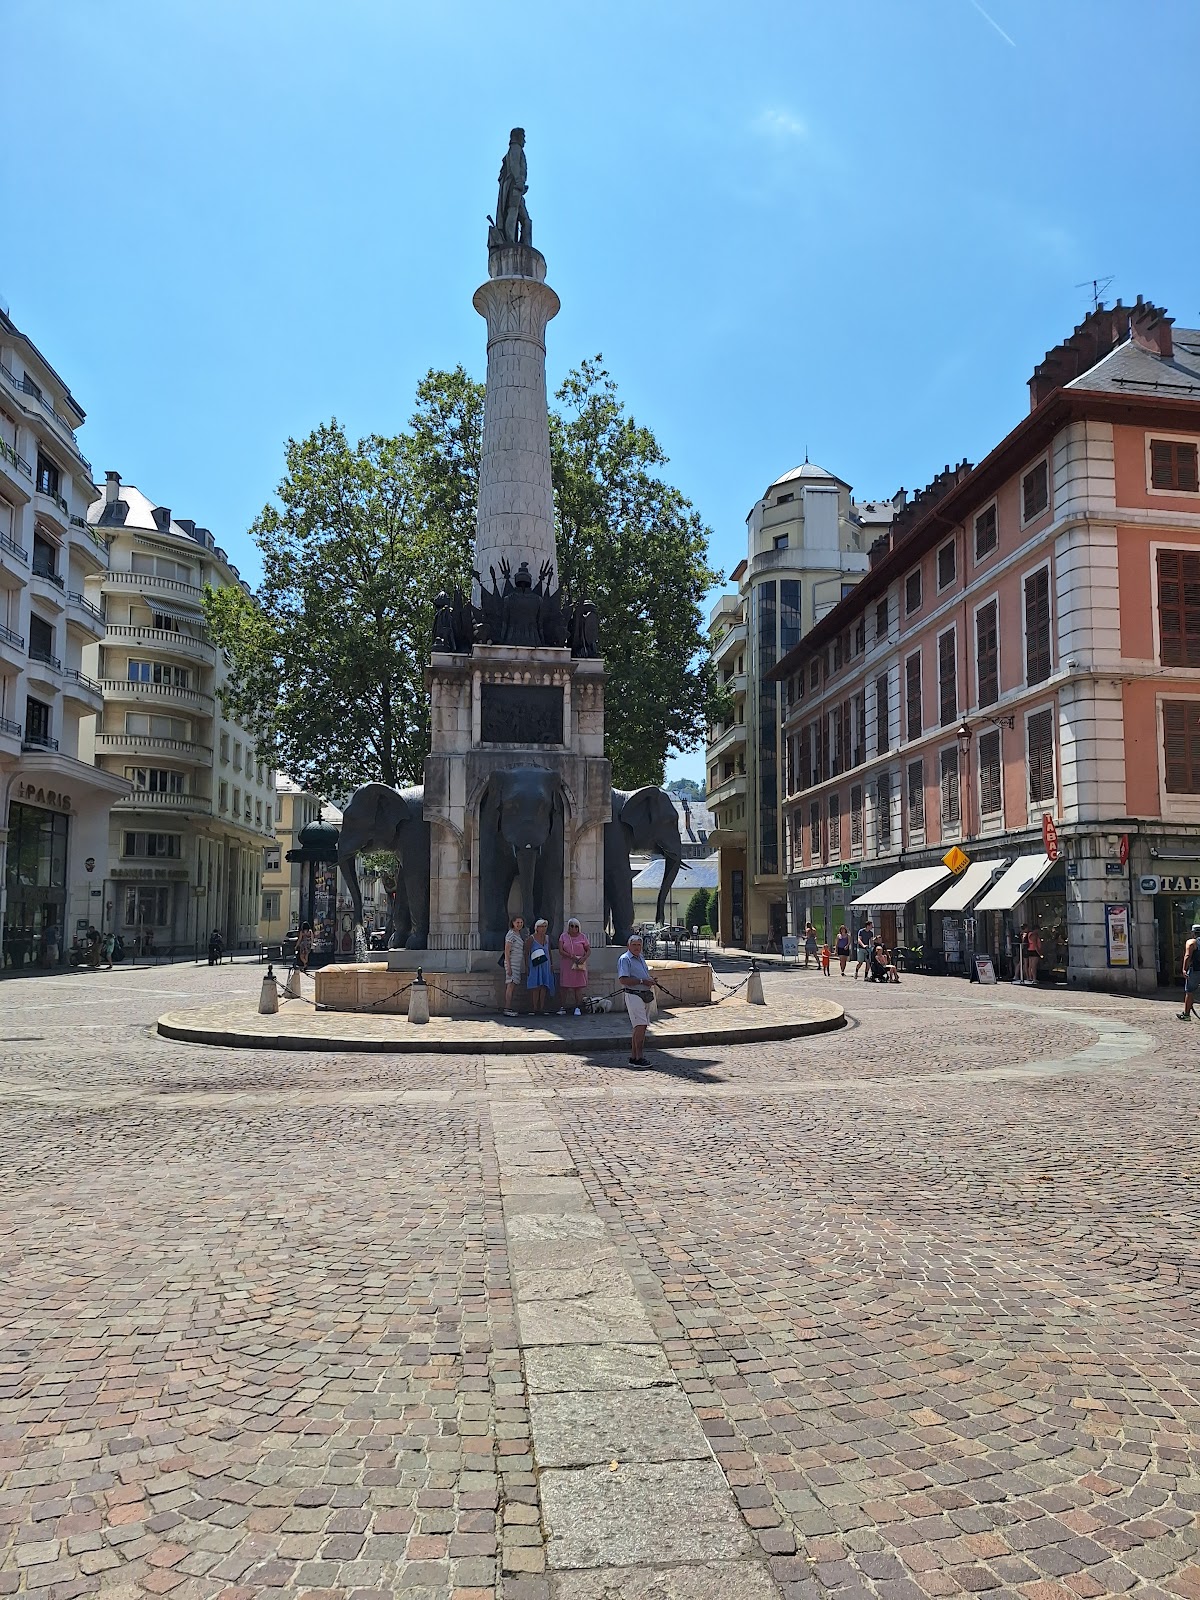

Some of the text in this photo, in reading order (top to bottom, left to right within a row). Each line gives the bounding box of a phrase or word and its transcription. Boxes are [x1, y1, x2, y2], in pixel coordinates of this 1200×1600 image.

[26, 784, 71, 810] PARIS
[1045, 815, 1057, 859] TABAC
[954, 858, 969, 873] PRESSE
